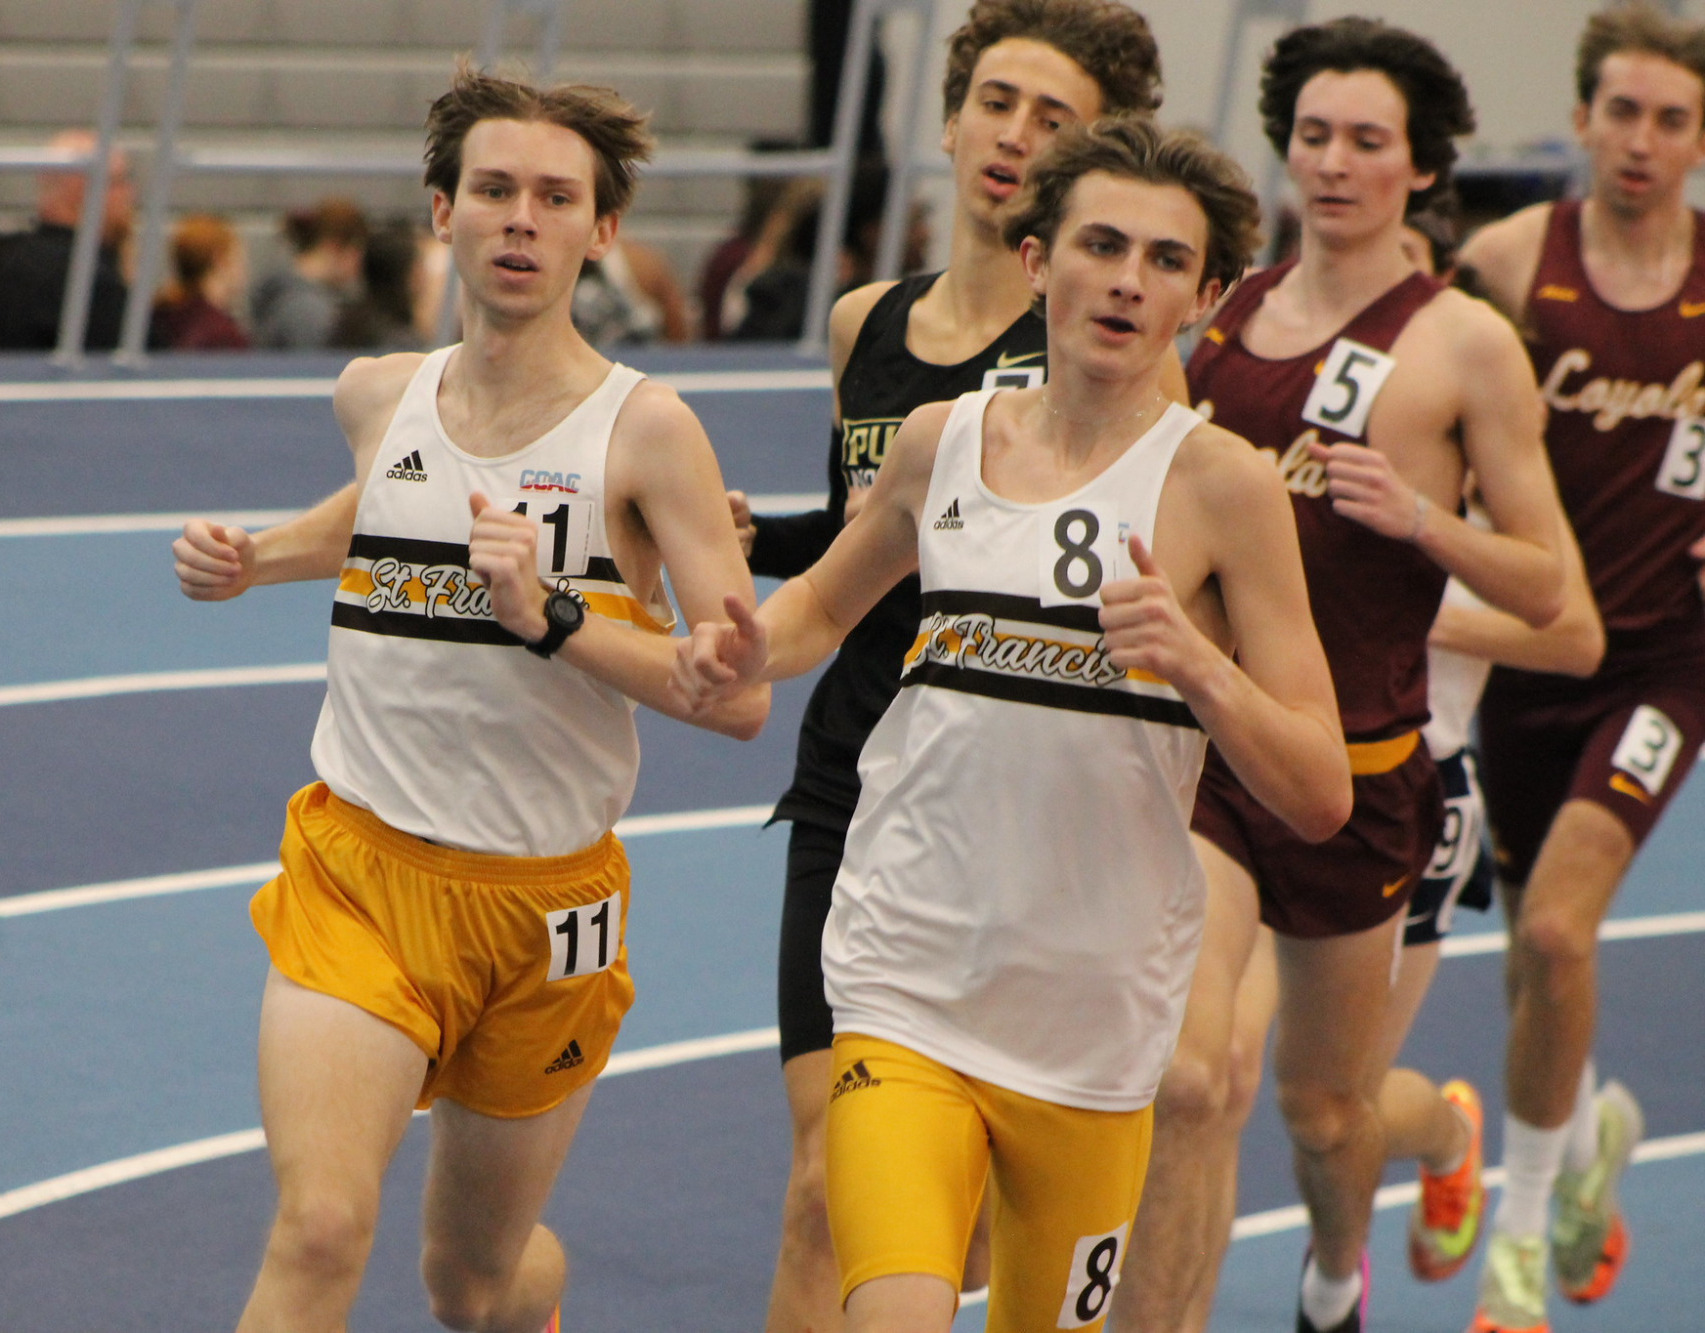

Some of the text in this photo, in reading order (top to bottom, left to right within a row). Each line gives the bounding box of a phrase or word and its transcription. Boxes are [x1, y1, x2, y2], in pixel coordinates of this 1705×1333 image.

[1319, 350, 1377, 424] 5
[386, 468, 428, 482] adidas
[847, 424, 899, 466] PU
[1670, 423, 1705, 488] 3
[933, 518, 964, 530] adidas
[1053, 508, 1103, 598] 8
[366, 557, 412, 614] St.
[953, 612, 1128, 686] Francis
[1629, 718, 1670, 773] 3
[1433, 806, 1464, 872] 9
[555, 901, 609, 976] 11
[544, 1055, 585, 1075] adidas
[1075, 1236, 1118, 1322] 8
